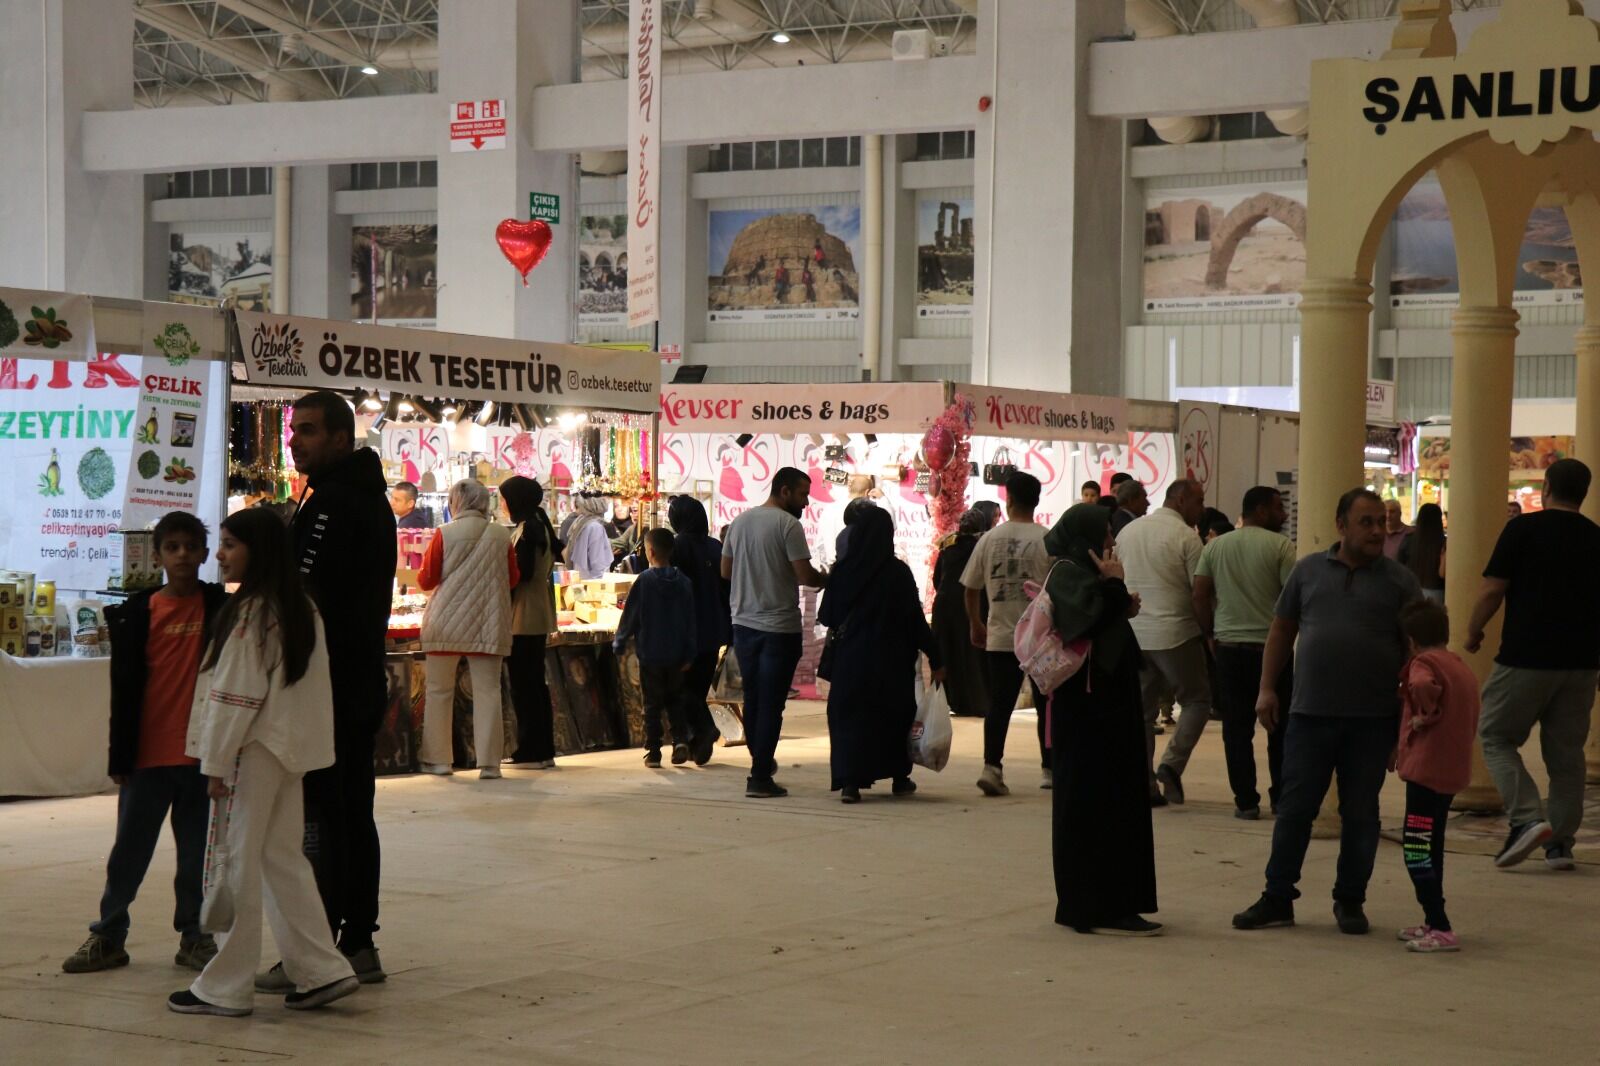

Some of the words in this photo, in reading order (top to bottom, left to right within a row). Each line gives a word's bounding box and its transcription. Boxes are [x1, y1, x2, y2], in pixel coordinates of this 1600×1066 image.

[531, 206, 559, 218] KAPISI
[533, 195, 556, 207] ÇIKIŞ
[252, 328, 292, 359] Özbek
[263, 358, 308, 377] Tesettür
[319, 332, 422, 384] ÖZBEK
[430, 352, 563, 395] TESETTÜR
[581, 374, 653, 393] ozbek.tesettur
[144, 374, 203, 397] ÇELİK
[658, 392, 743, 427] Kevser
[751, 401, 812, 420] shoes
[818, 400, 834, 421] &
[839, 401, 890, 424] bags
[986, 395, 1043, 430] Kevser
[1044, 409, 1078, 428] shoes
[1081, 410, 1089, 430] &
[1091, 411, 1115, 434] bags
[84, 509, 94, 519] 47
[96, 509, 106, 519] 70
[312, 513, 329, 540] NOT
[41, 546, 79, 561] trendyol
[88, 547, 109, 562] Çelik
[299, 548, 317, 574] FOR
